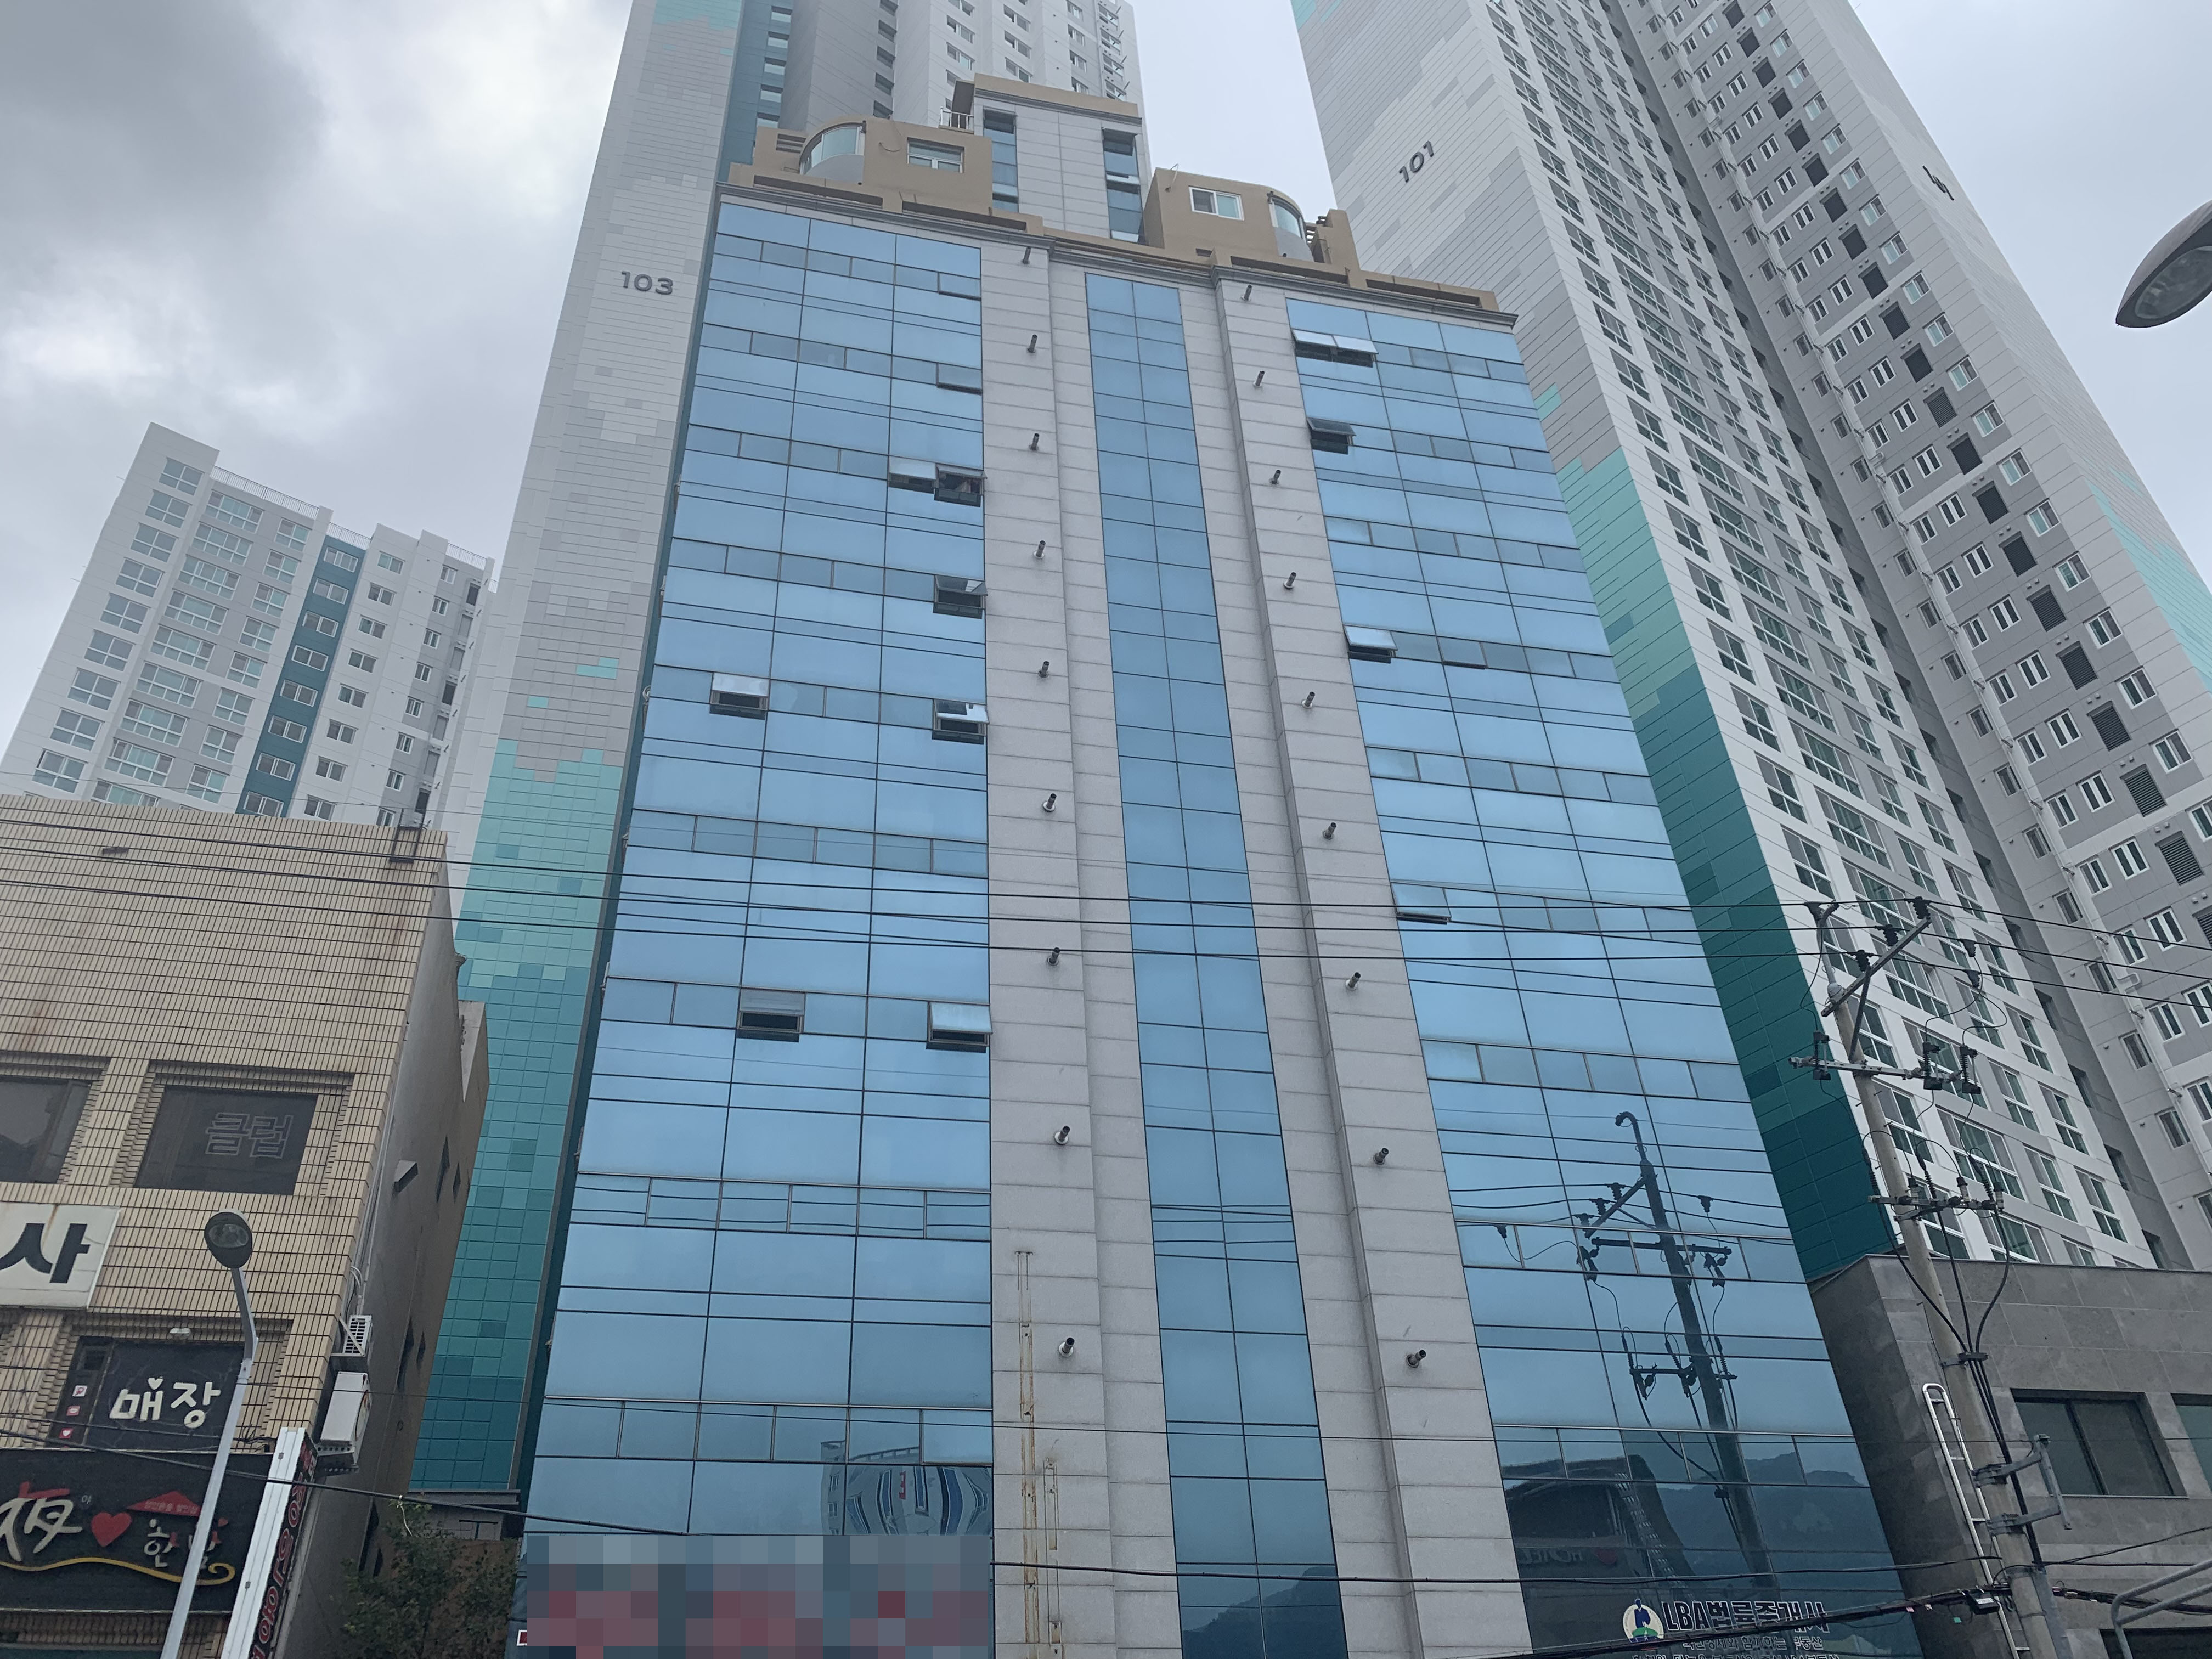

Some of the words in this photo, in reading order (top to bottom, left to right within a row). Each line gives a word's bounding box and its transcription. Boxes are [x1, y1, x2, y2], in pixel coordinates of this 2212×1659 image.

[1398, 140, 1435, 183] 101
[621, 270, 673, 295] 103
[205, 1112, 294, 1159] 클럽
[0, 1223, 90, 1283] 사
[109, 1381, 221, 1429] 매장
